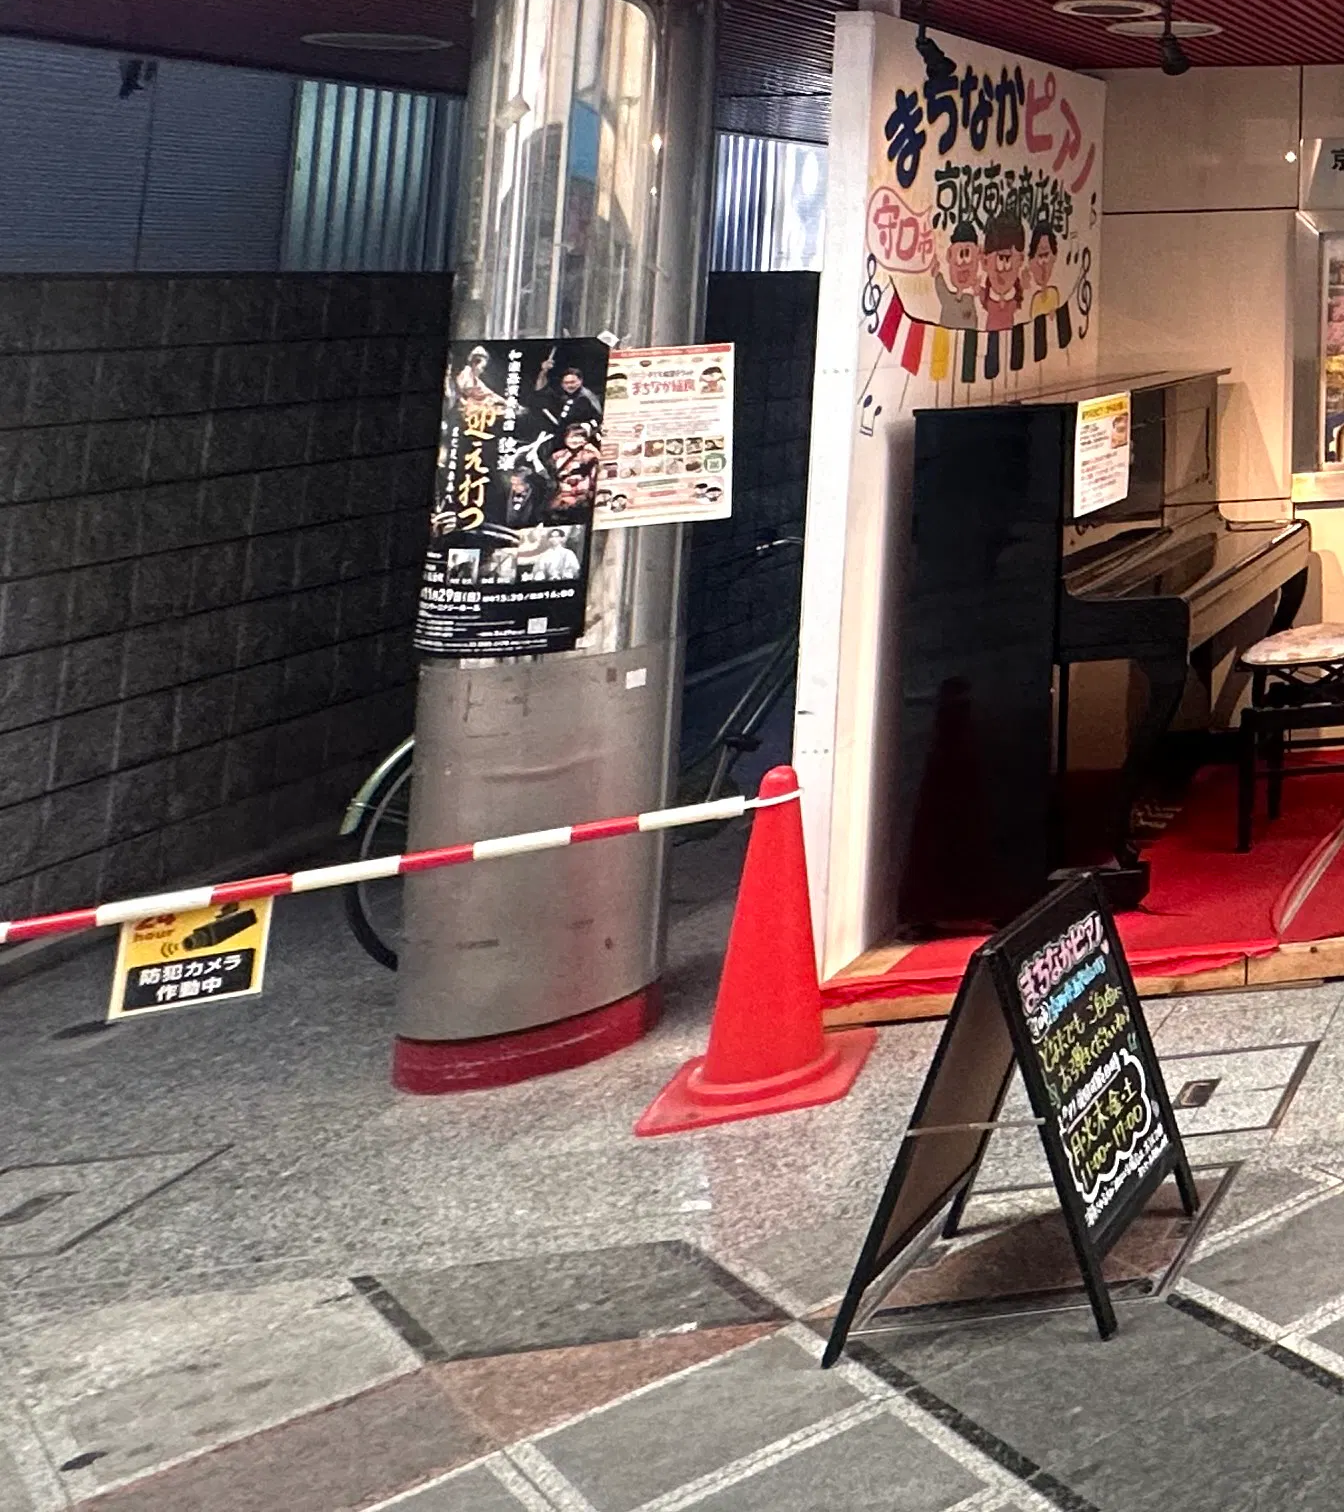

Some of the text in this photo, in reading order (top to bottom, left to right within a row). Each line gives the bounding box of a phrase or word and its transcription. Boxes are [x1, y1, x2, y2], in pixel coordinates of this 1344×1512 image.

[885, 64, 1096, 195] まちなかピアノ
[138, 954, 243, 988] 防犯カメラ
[155, 976, 223, 1002] 作動中
